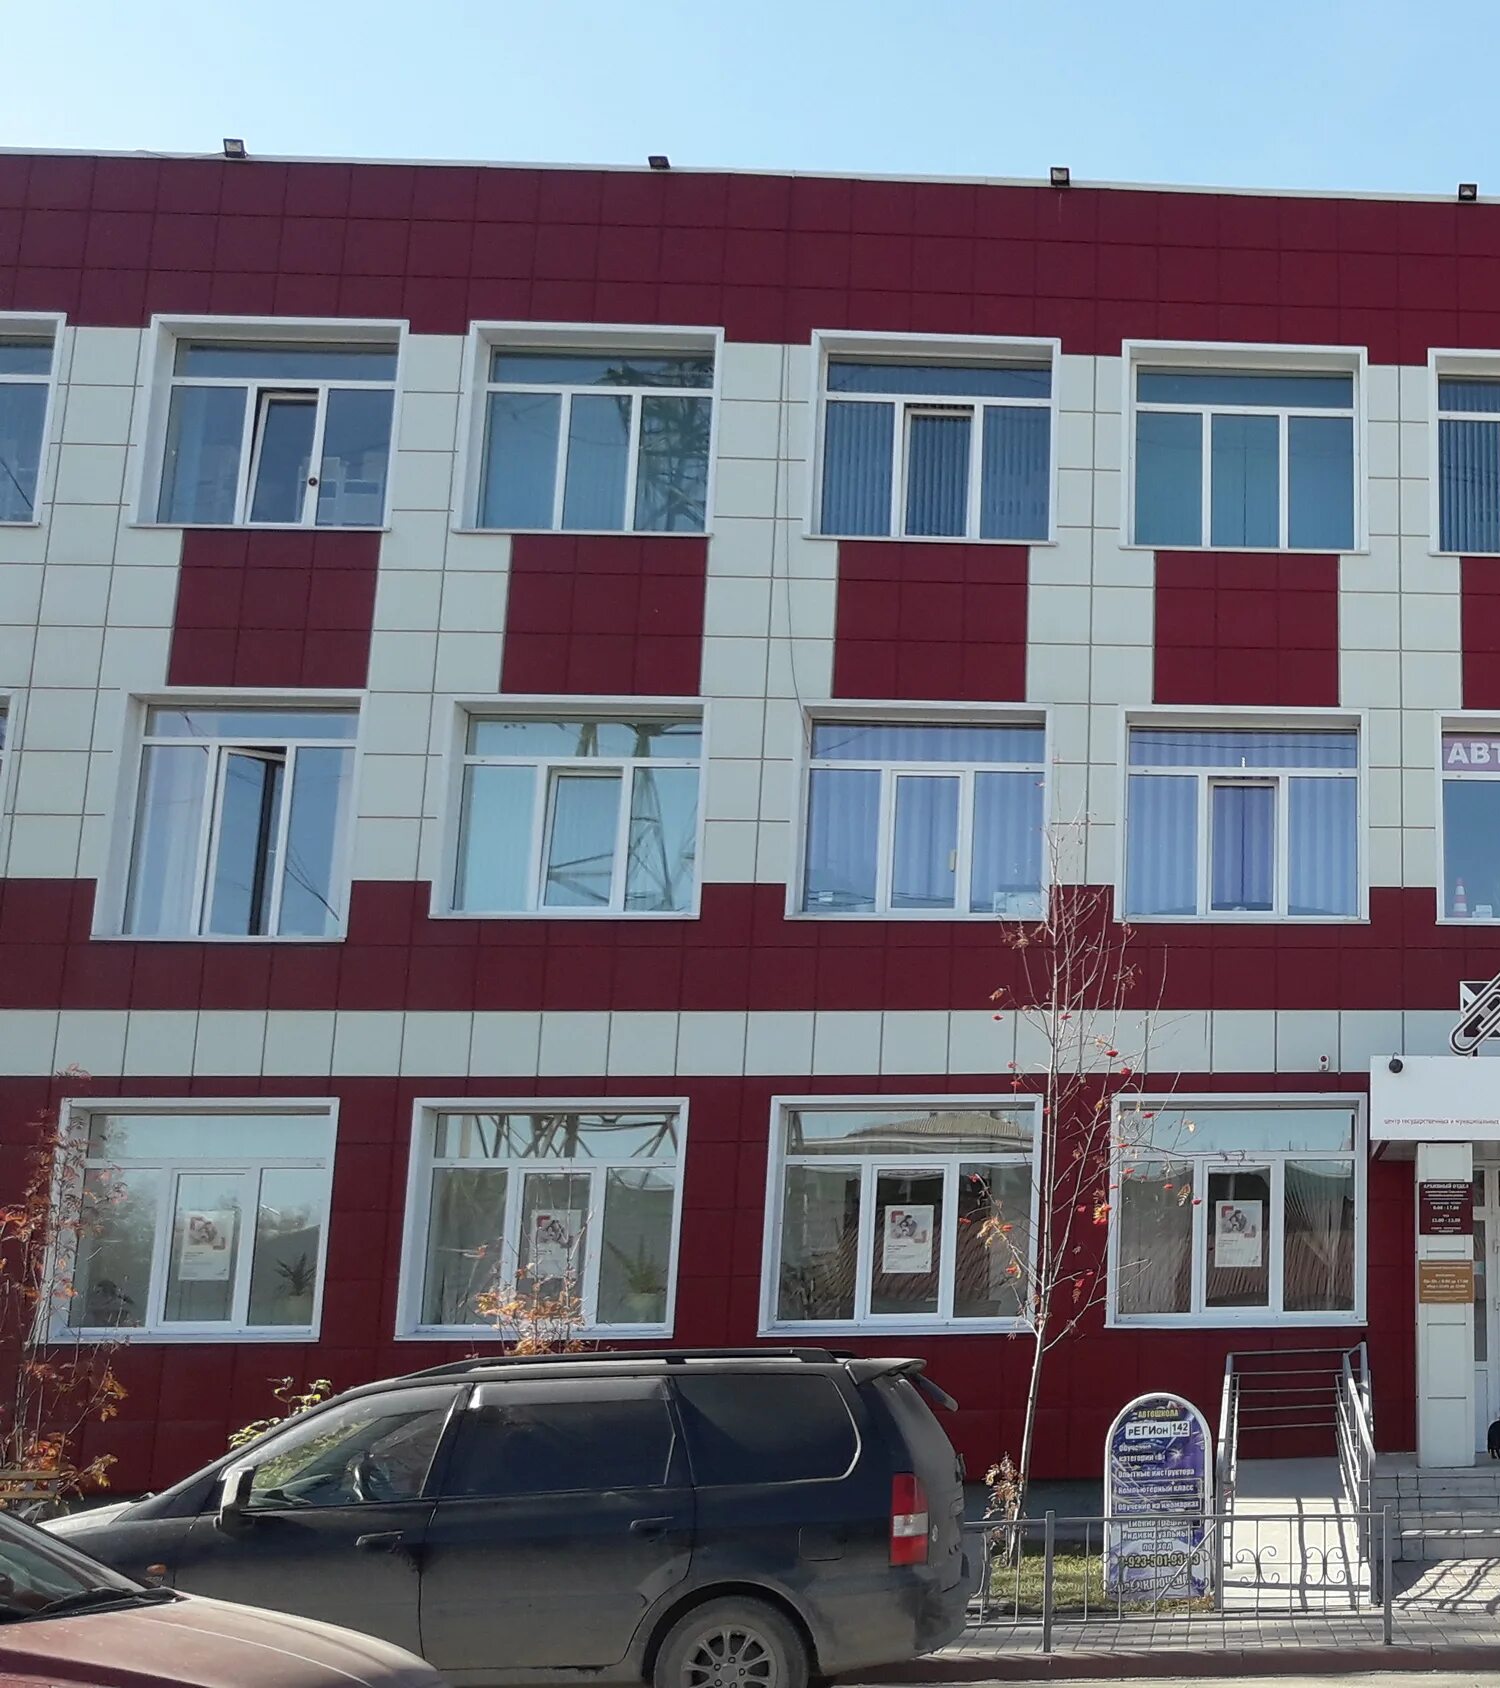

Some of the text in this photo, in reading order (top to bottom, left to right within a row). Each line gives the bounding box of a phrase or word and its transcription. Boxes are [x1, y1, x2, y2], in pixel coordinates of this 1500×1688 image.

[1137, 1409, 1179, 1418] АВТОШКОЛА
[1172, 1423, 1188, 1431] 142
[1118, 1468, 1195, 1478] Опытные инструктора
